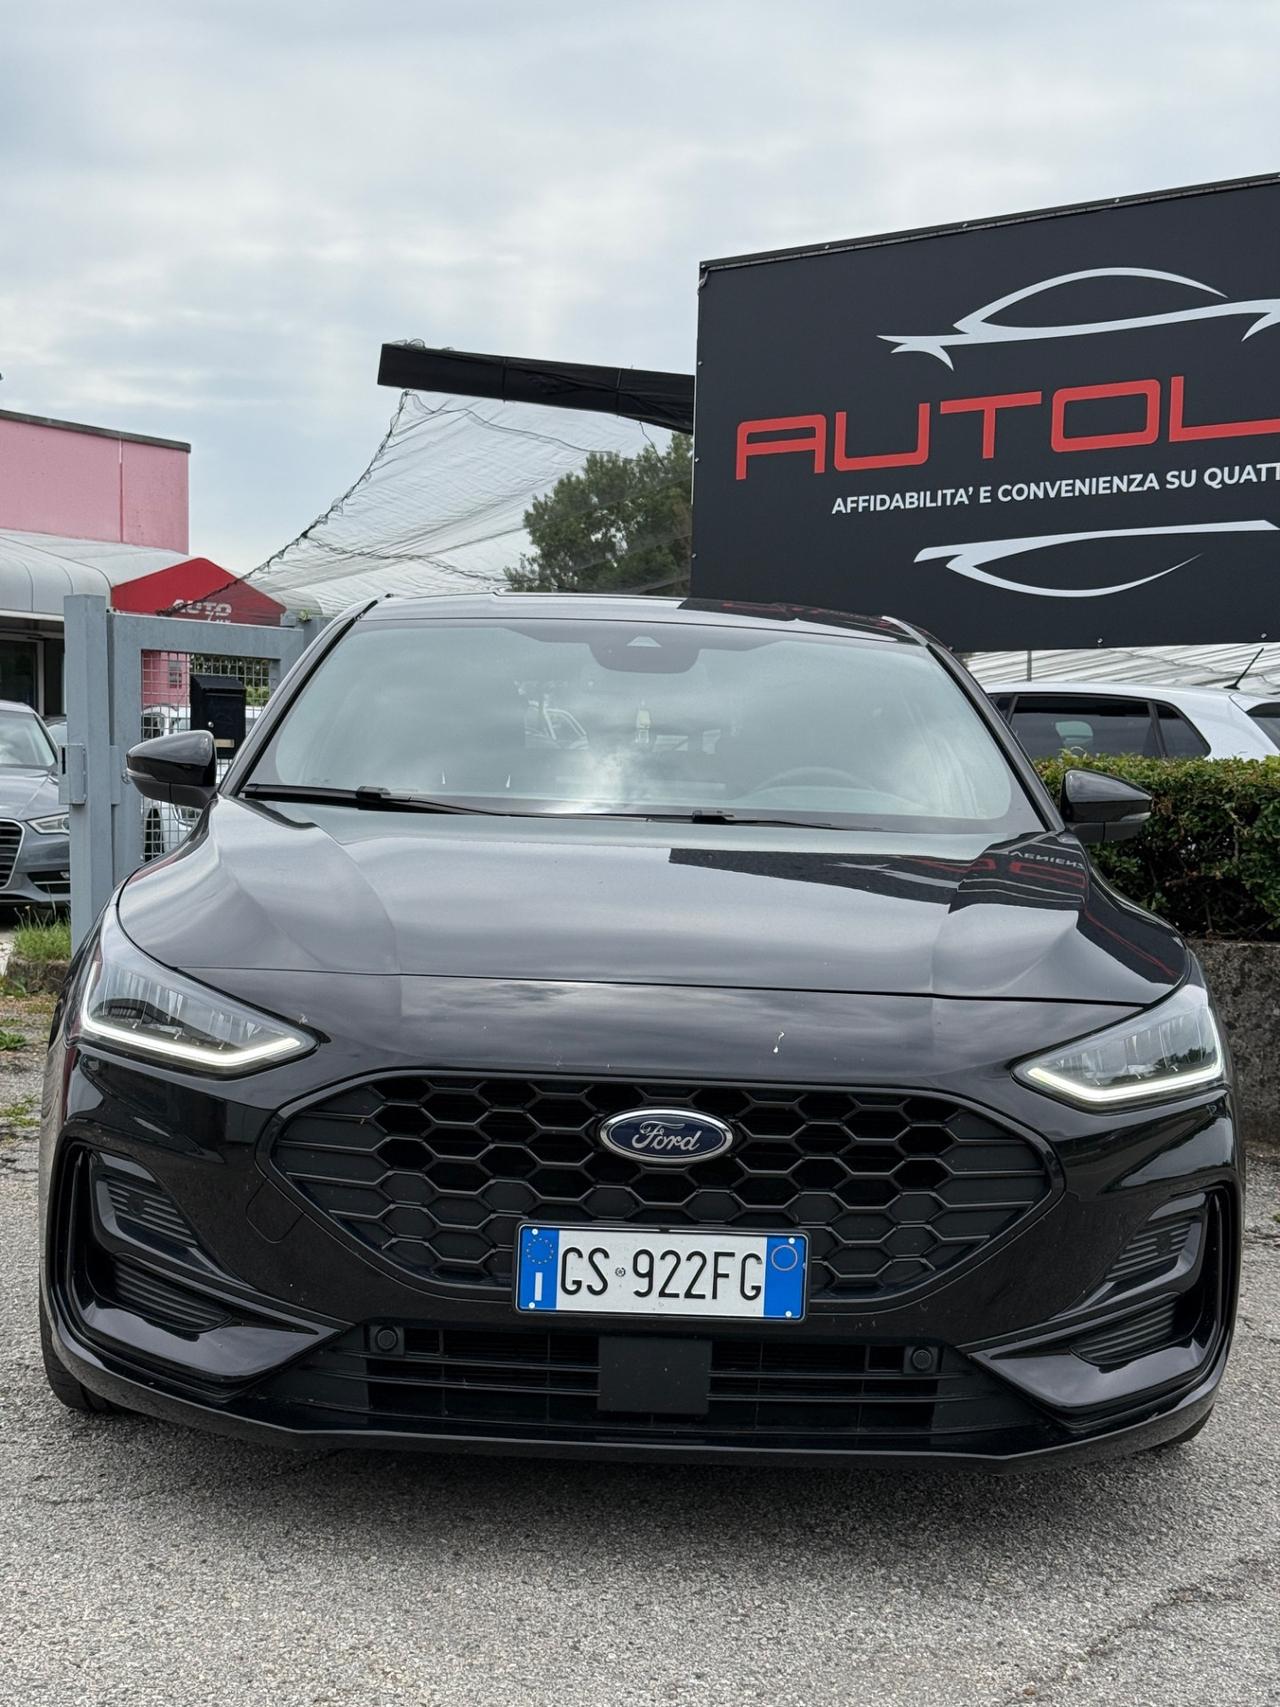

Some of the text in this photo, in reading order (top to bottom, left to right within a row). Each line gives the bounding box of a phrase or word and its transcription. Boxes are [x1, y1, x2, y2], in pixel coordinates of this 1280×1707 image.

[735, 375, 1280, 480] AUTOL
[831, 486, 974, 514] AFFIDABILITA'
[979, 486, 992, 503] E
[997, 473, 1160, 502] CONVENIENZA
[1165, 469, 1197, 489] SU
[631, 1120, 701, 1150] Ford
[560, 1246, 762, 1301] GS 922FG
